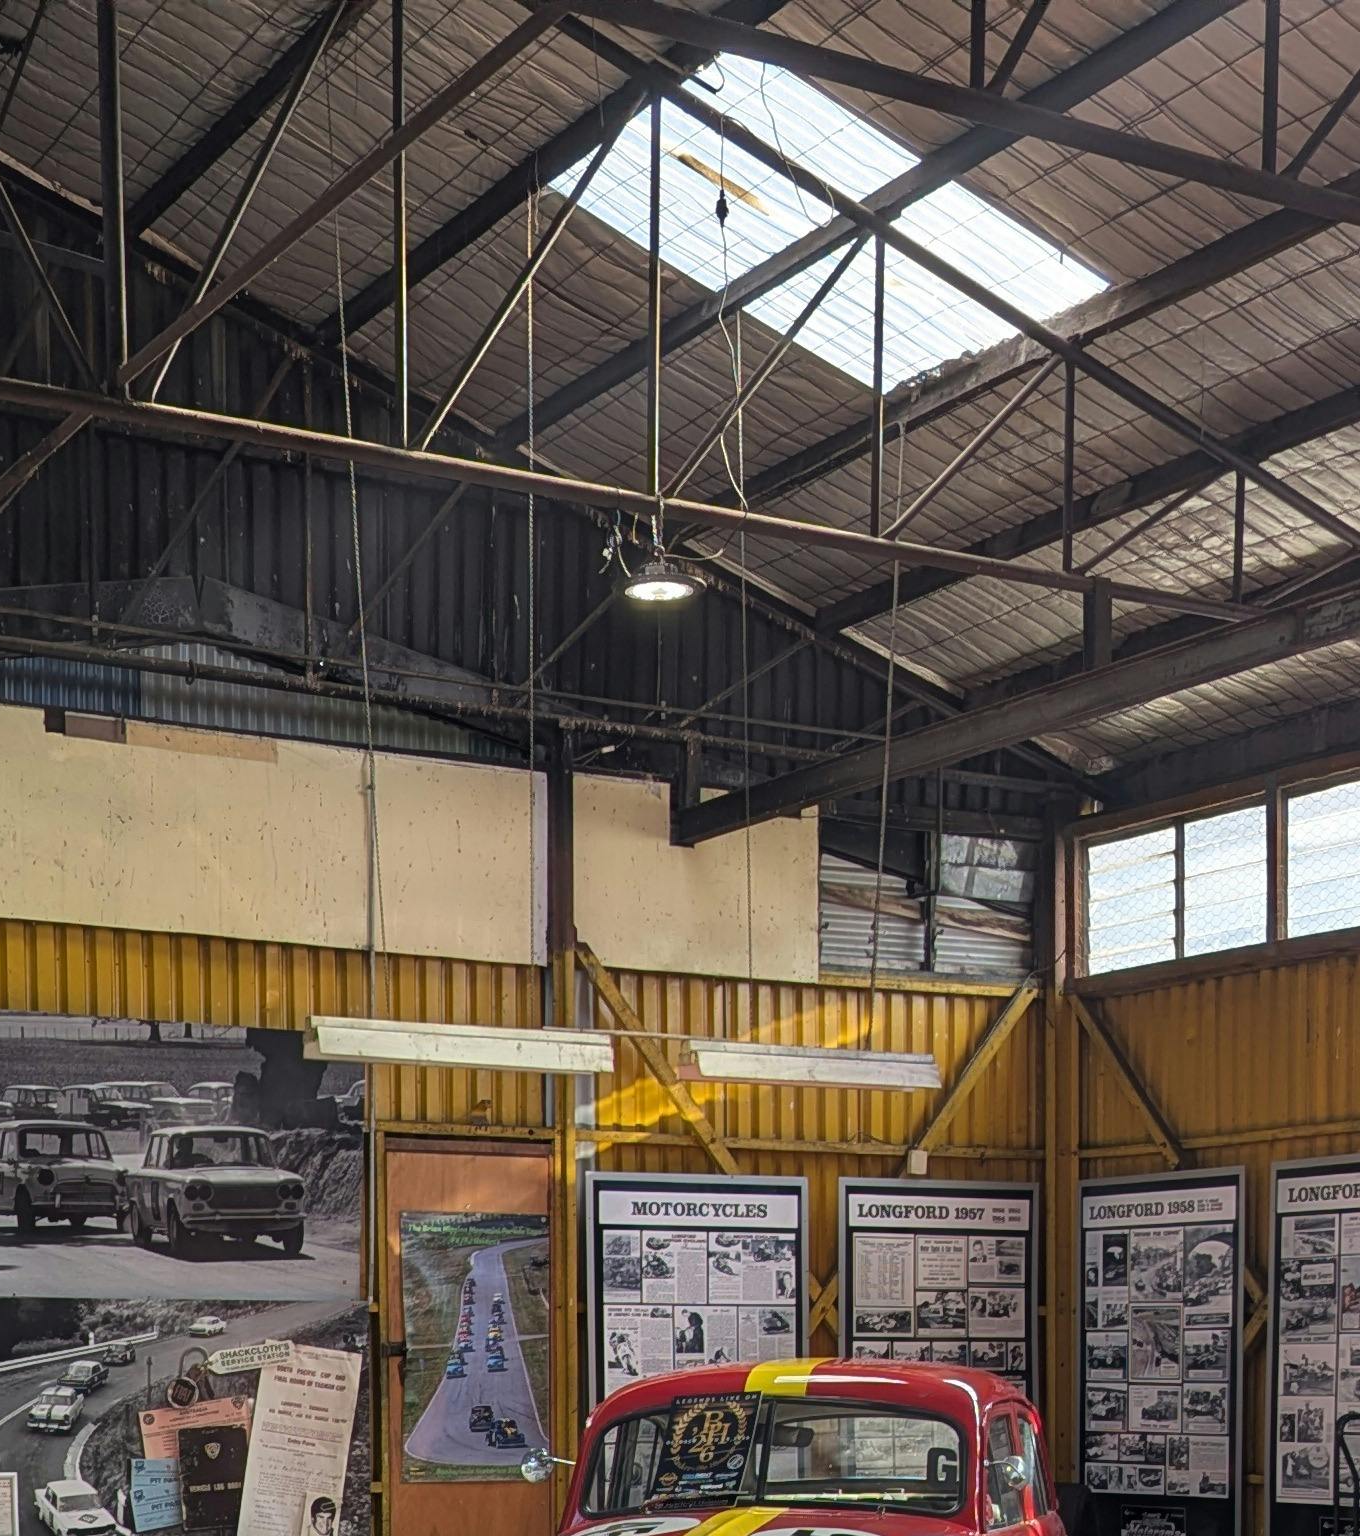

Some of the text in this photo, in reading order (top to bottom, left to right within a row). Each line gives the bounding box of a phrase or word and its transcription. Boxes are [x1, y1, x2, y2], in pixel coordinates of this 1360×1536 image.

[631, 1201, 768, 1218] MOTORCYCLES
[858, 1203, 949, 1220] LONGFORD
[954, 1207, 985, 1220] 1957
[1089, 1202, 1164, 1220] LONGFORD
[1167, 1200, 1195, 1214] 1958
[220, 1343, 290, 1360] SHACKCLOTH'S
[221, 1356, 255, 1366] SERVICE
[257, 1351, 290, 1361] STATION
[927, 1447, 957, 1488] G
